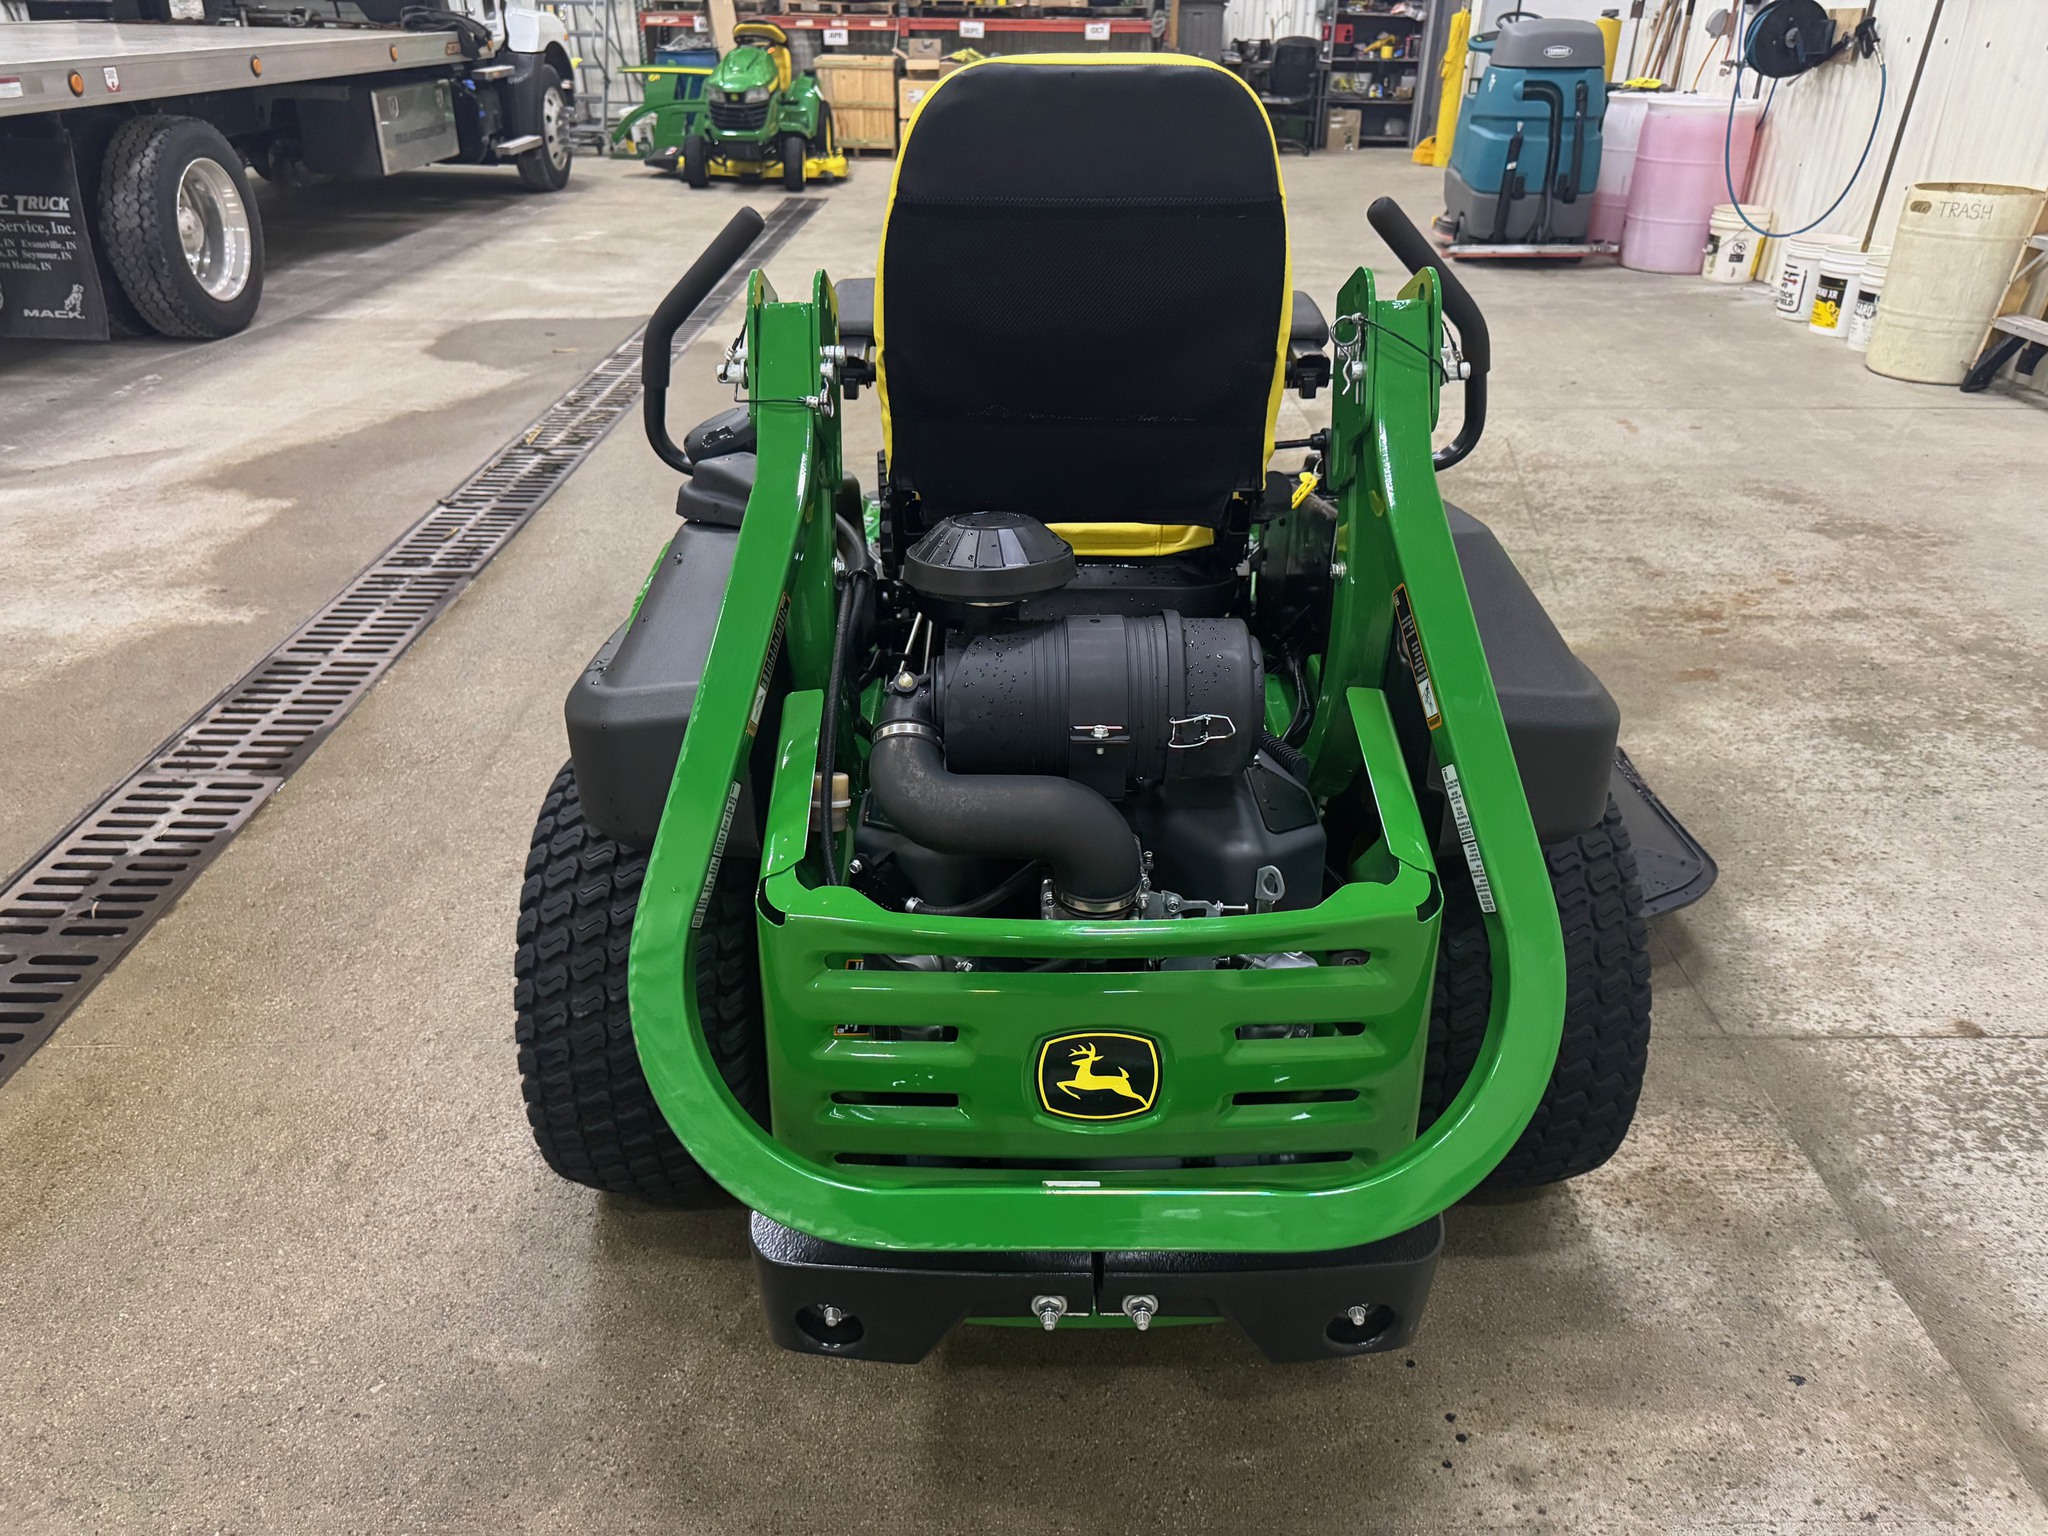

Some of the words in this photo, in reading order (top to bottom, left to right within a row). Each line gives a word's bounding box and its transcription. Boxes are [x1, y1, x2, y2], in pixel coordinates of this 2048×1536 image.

[14, 195, 71, 216] TRUCK
[1939, 200, 1994, 221] TRASH
[50, 220, 76, 236] Inc.
[23, 308, 82, 319] MACK
